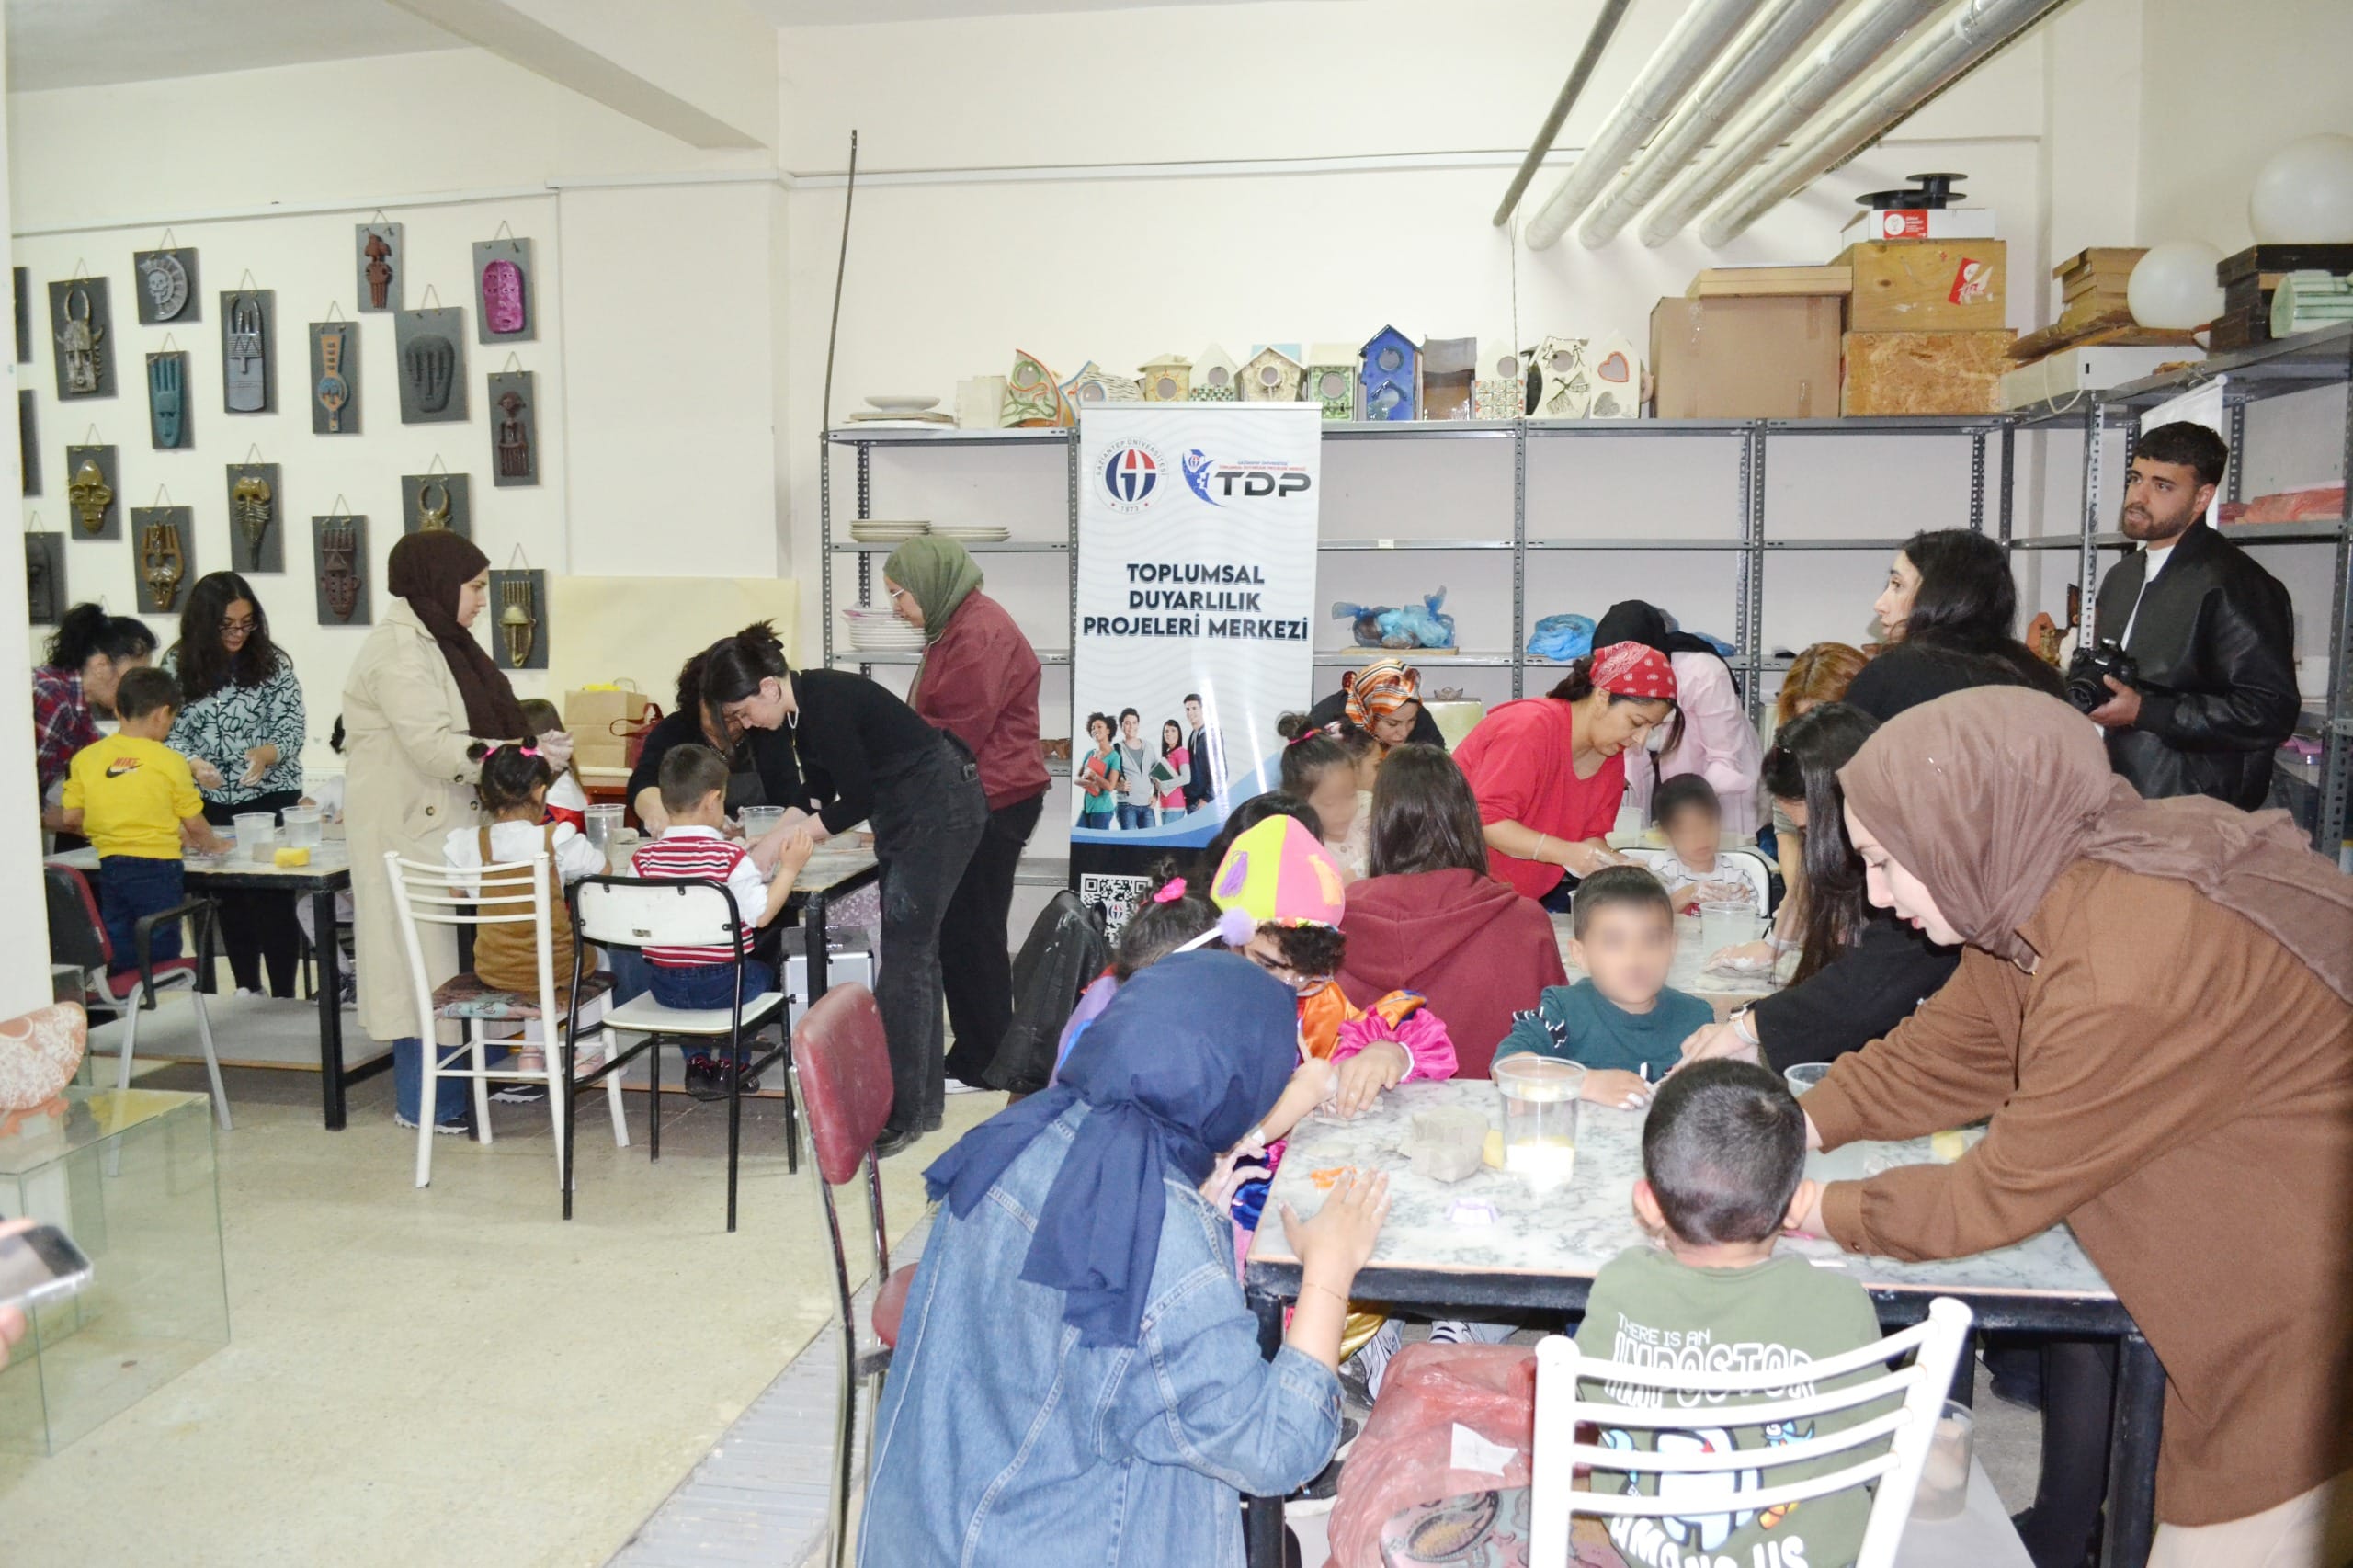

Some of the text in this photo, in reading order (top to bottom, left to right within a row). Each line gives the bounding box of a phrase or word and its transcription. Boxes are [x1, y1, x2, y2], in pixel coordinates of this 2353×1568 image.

[1214, 472, 1312, 497] TDP
[1127, 563, 1265, 585] TOPLUMSAL
[1129, 590, 1262, 612] DUYARLILIK
[1083, 613, 1308, 641] PROJELERİ MERKEZİ
[113, 756, 140, 767] NIKE
[1618, 1312, 1711, 1347] THERE IS AN
